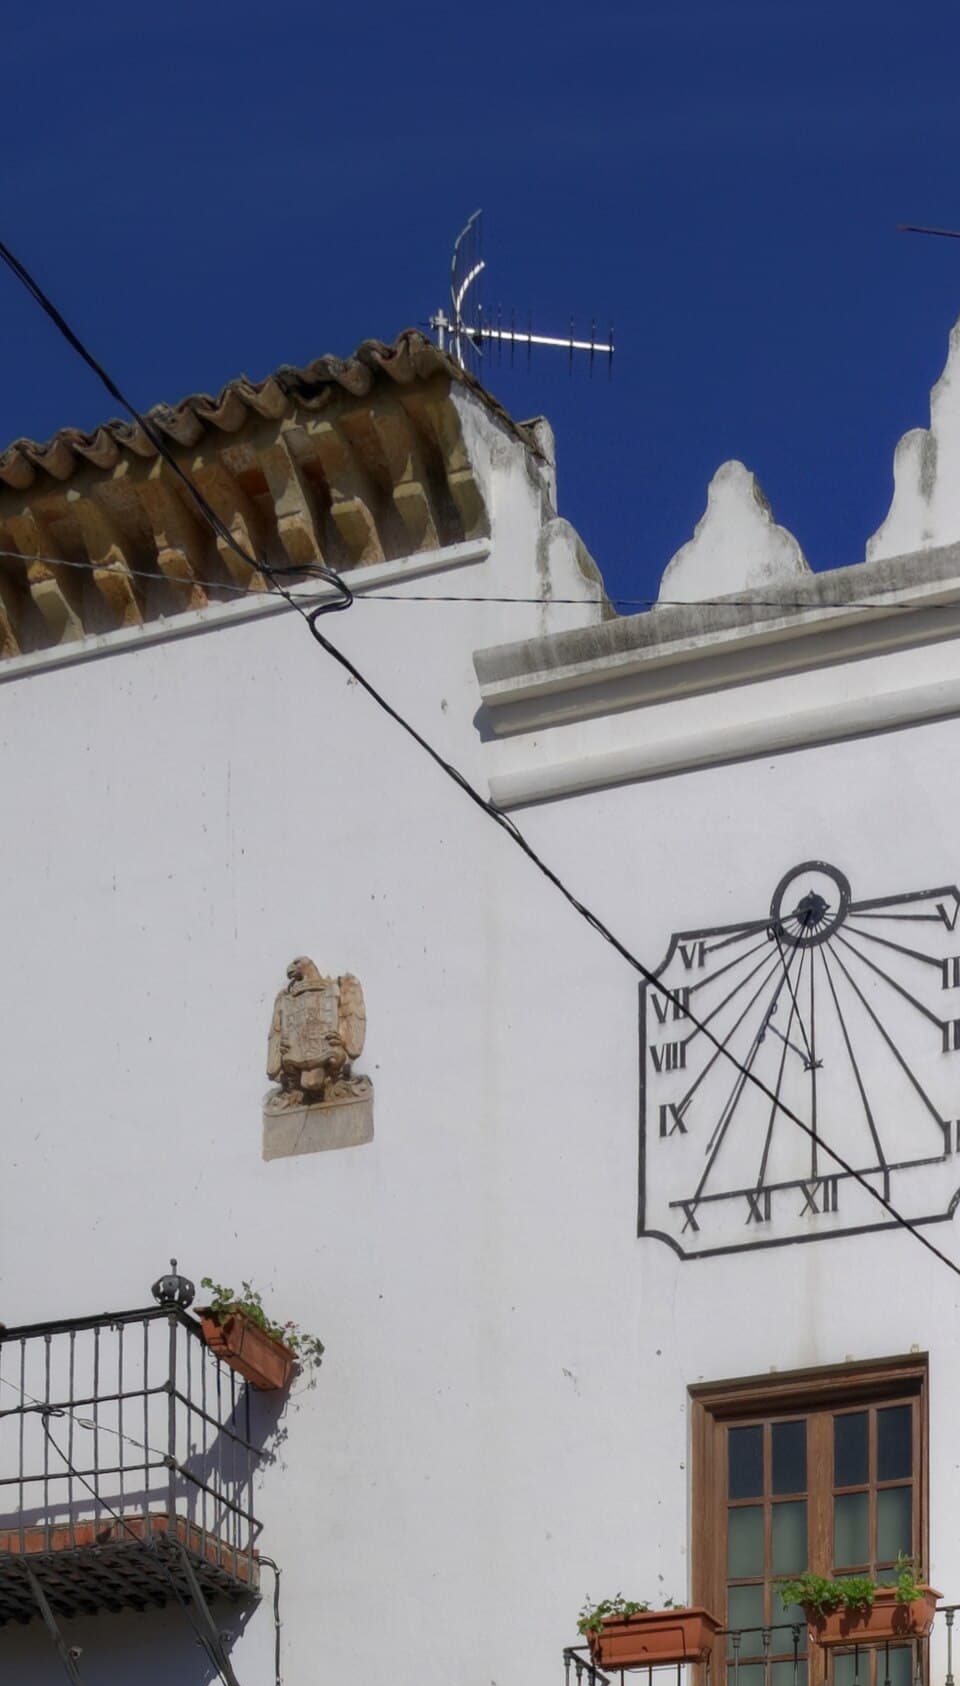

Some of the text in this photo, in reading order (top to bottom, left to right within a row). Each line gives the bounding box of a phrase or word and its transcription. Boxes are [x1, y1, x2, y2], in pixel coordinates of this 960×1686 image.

[936, 902, 960, 932] V
[678, 940, 707, 969] VI
[649, 1040, 688, 1073] VIII
[658, 1099, 692, 1138] IX
[745, 1188, 772, 1225] XI
[799, 1178, 839, 1217] XII
[681, 1201, 700, 1234] X
